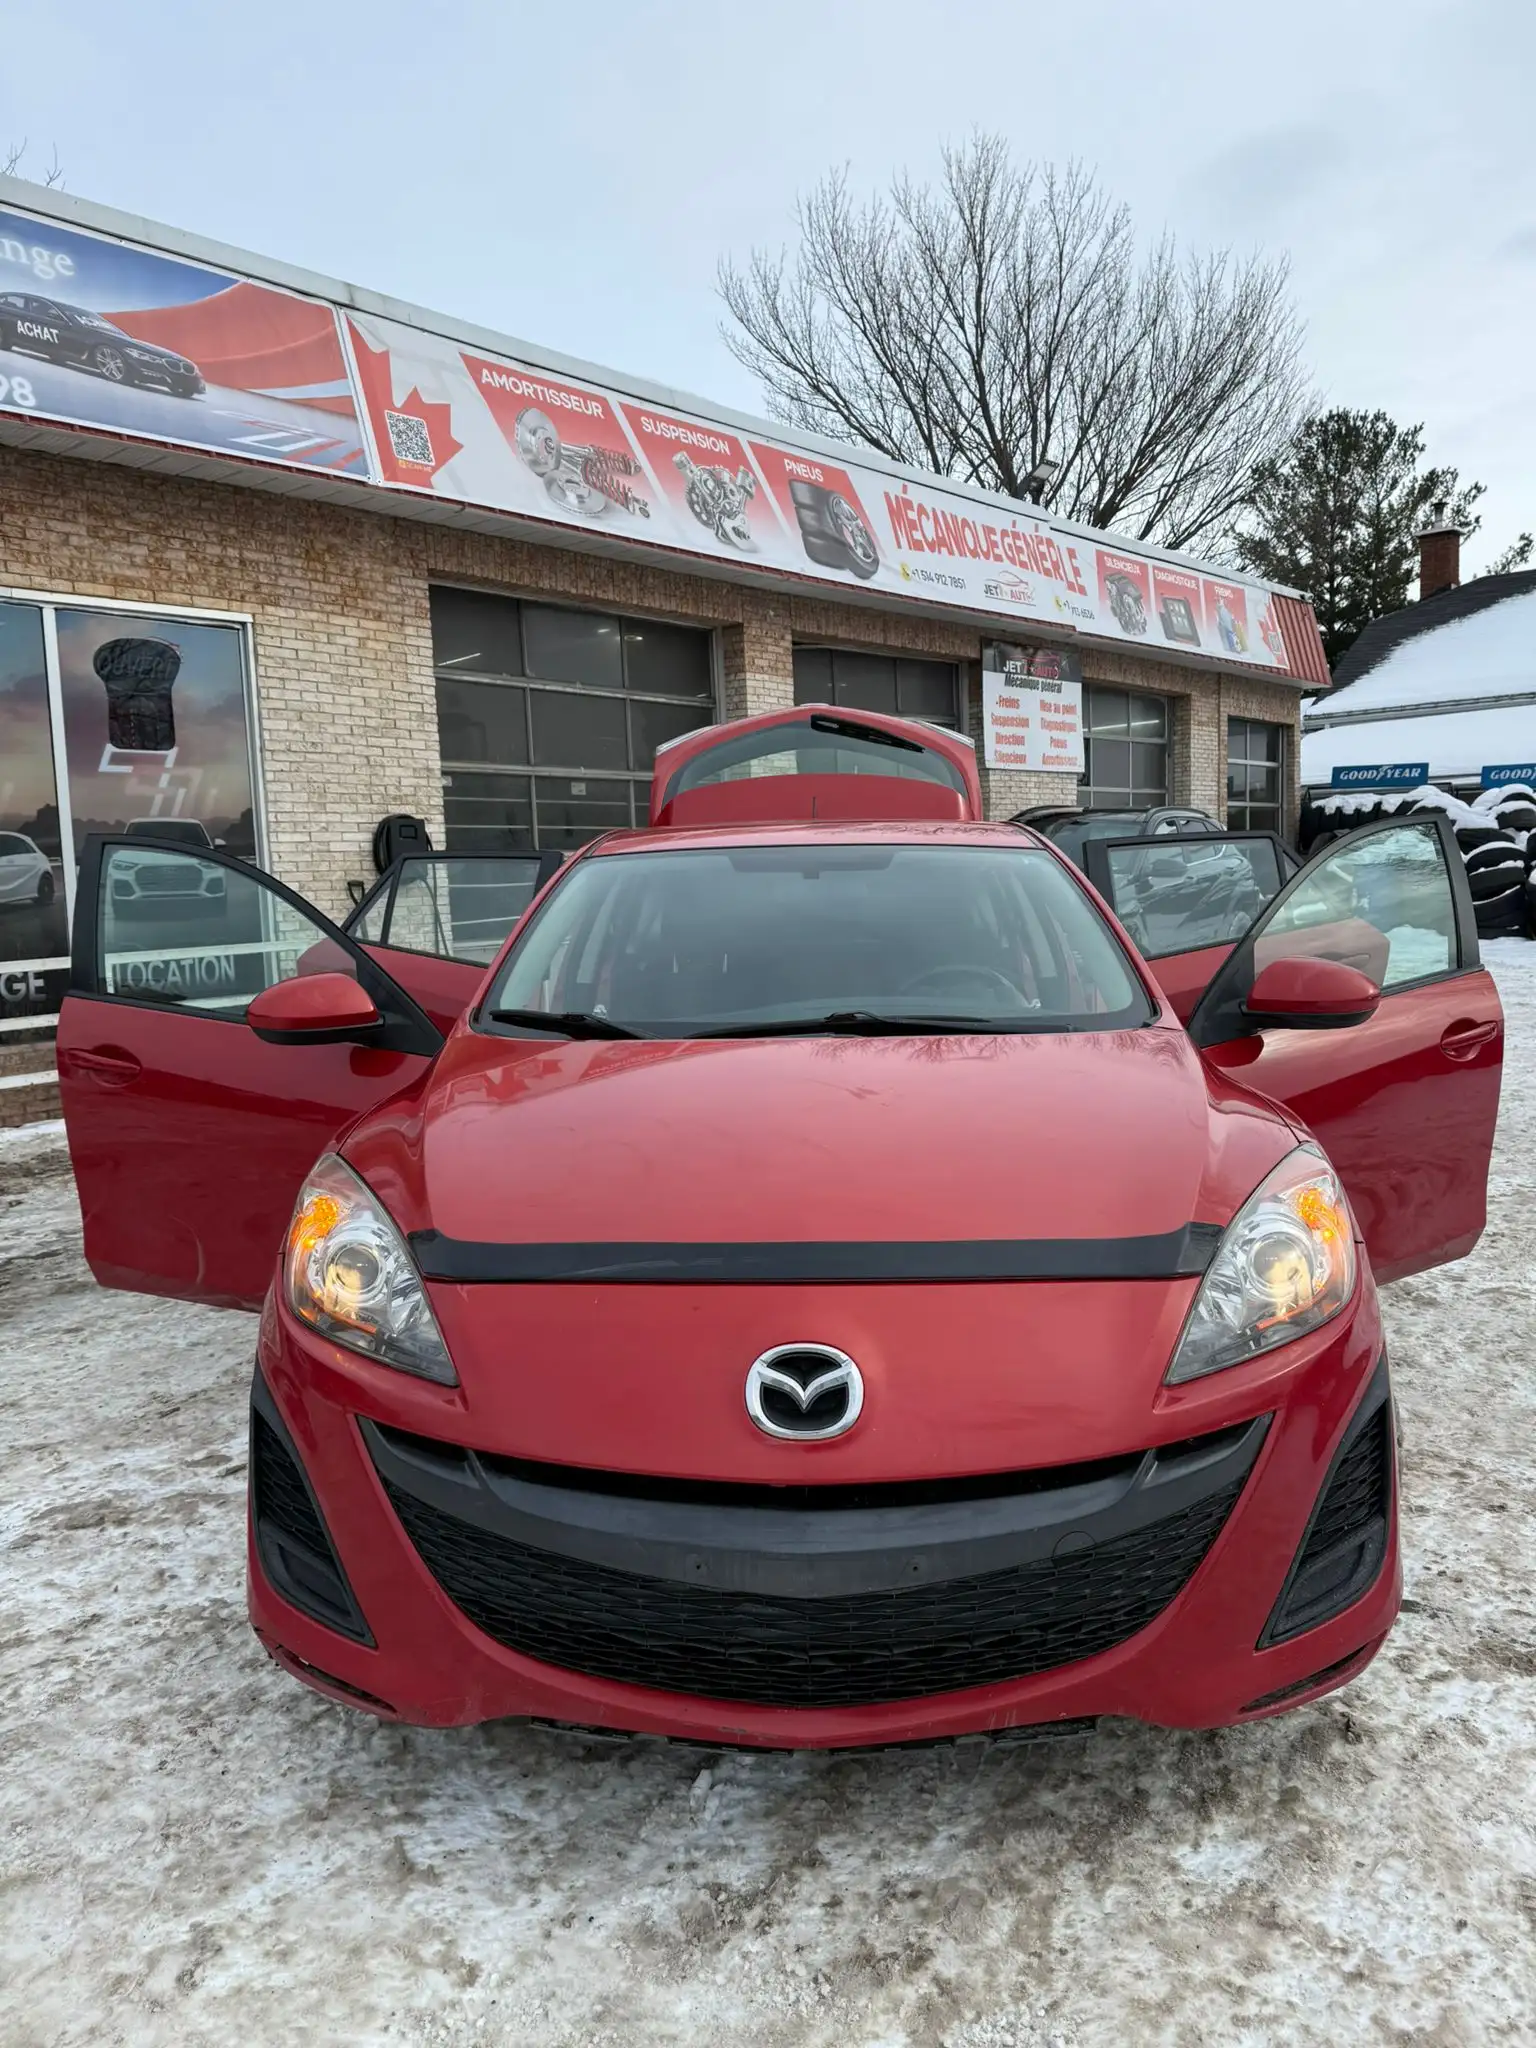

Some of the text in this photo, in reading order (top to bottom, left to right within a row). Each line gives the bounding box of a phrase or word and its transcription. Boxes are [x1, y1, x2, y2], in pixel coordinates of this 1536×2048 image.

[17, 320, 60, 344] ACHAT
[481, 368, 605, 419] AMORTISSEUR
[640, 416, 731, 455] SUSPENSION
[784, 458, 824, 482] PNEUS
[884, 483, 1003, 563] MÉCANIQUE
[921, 570, 935, 582] 514
[935, 573, 949, 586] 912
[1003, 660, 1022, 673] JET
[1340, 766, 1421, 781] GOODYEAR
[0, 970, 46, 1001] GE
[114, 954, 236, 991] LOCATION
